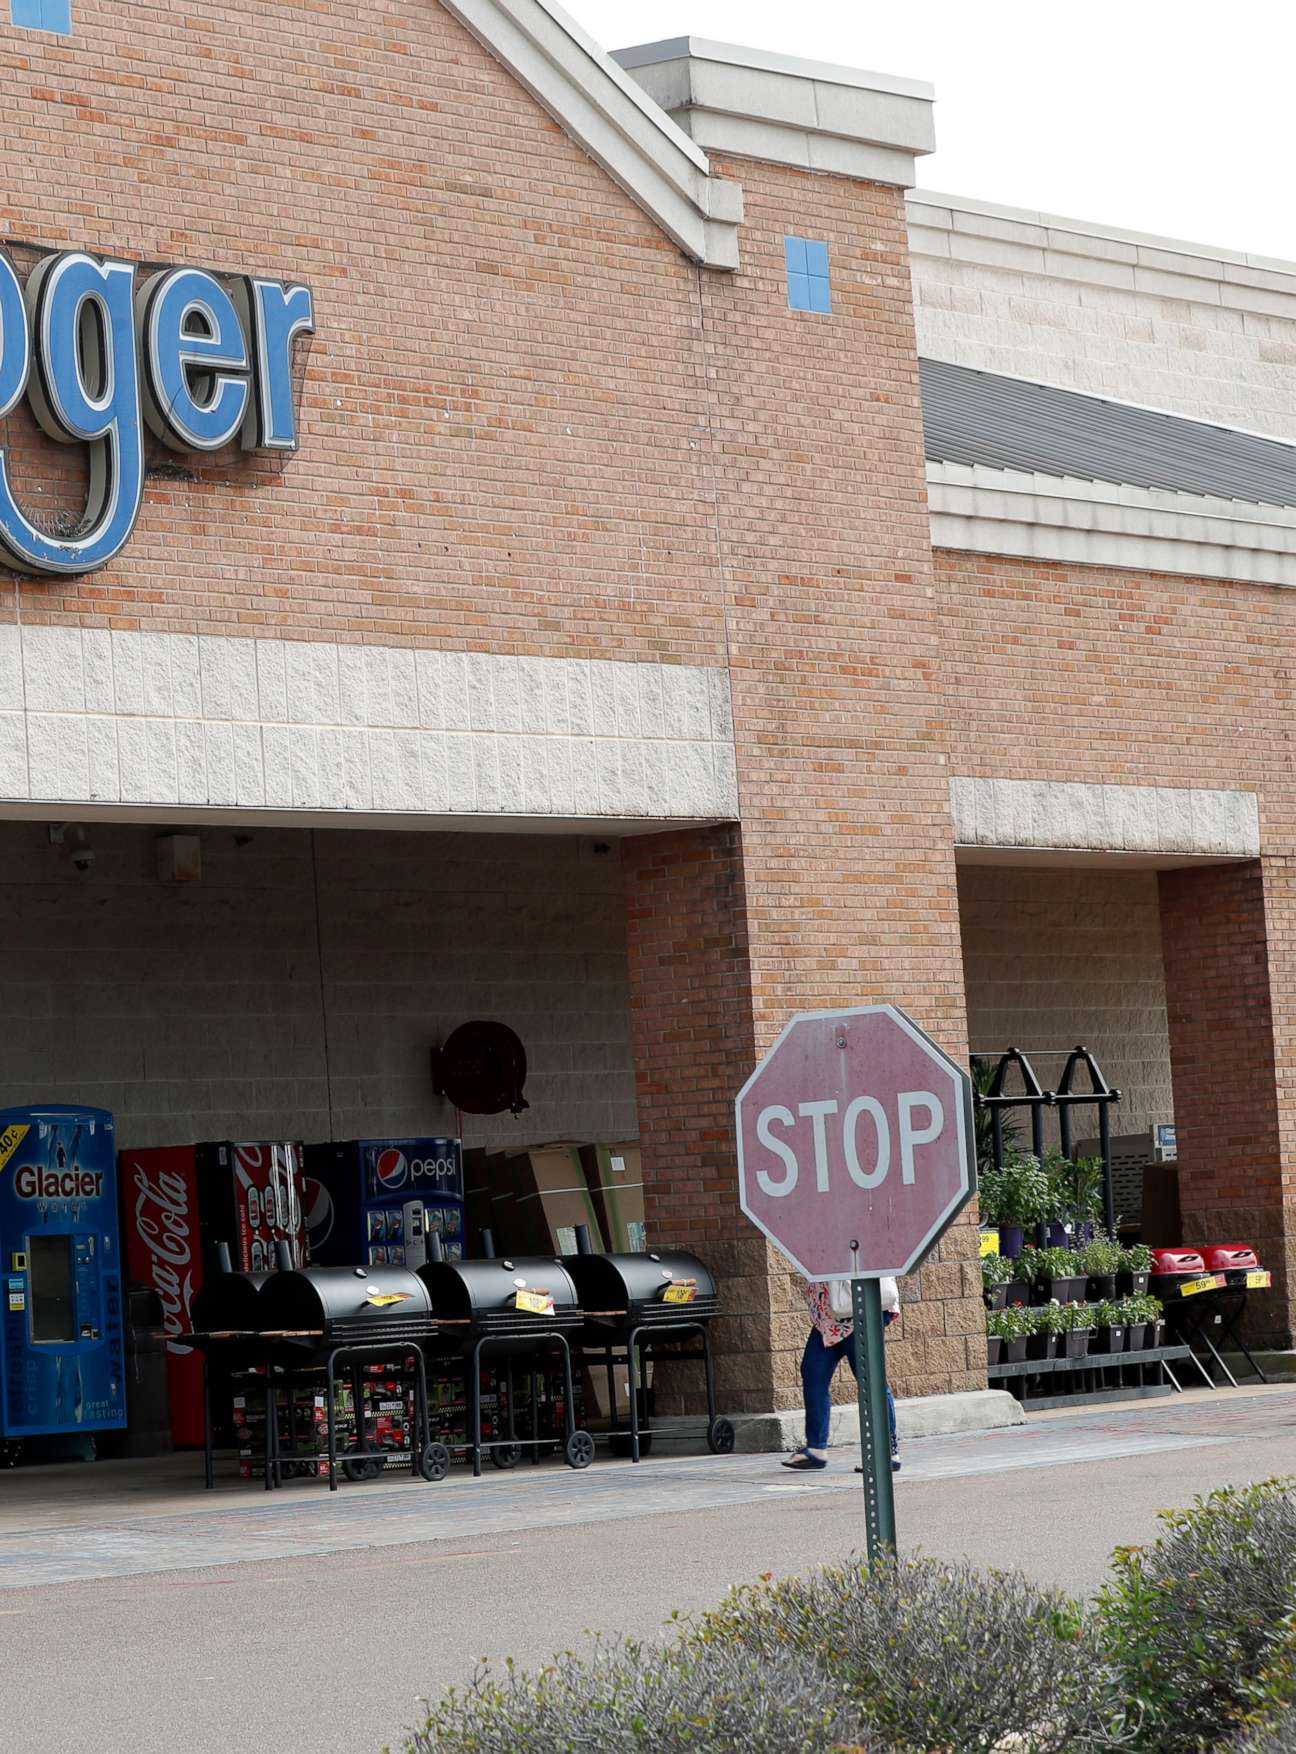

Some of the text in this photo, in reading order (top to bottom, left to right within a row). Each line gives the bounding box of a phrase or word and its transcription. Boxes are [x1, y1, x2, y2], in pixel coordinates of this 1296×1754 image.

[756, 1090, 944, 1197] STOP
[15, 1165, 103, 1198] Glacier
[410, 1153, 456, 1181] pepsi
